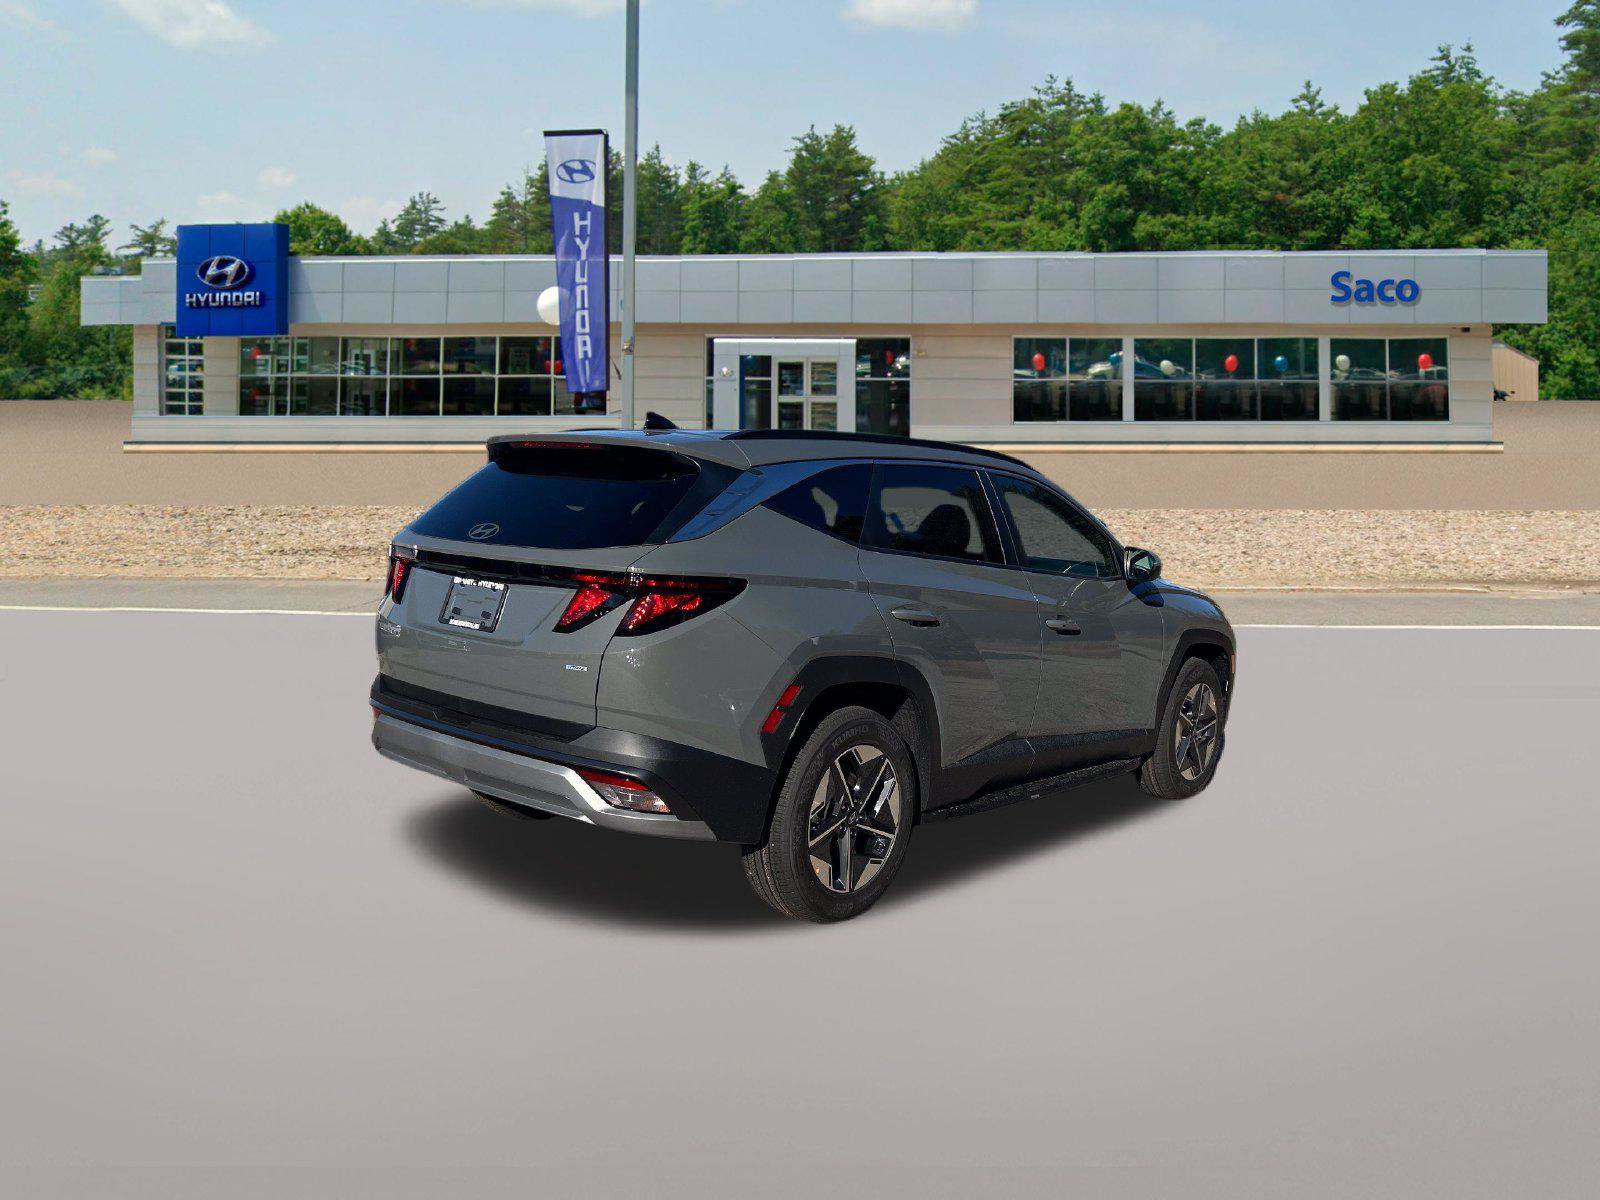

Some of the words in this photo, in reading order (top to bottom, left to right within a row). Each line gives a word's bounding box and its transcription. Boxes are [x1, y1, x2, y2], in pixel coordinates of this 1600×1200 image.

[185, 291, 261, 307] HYUNDAI
[573, 210, 592, 384] HYUNDAI
[1330, 270, 1420, 303] Saco
